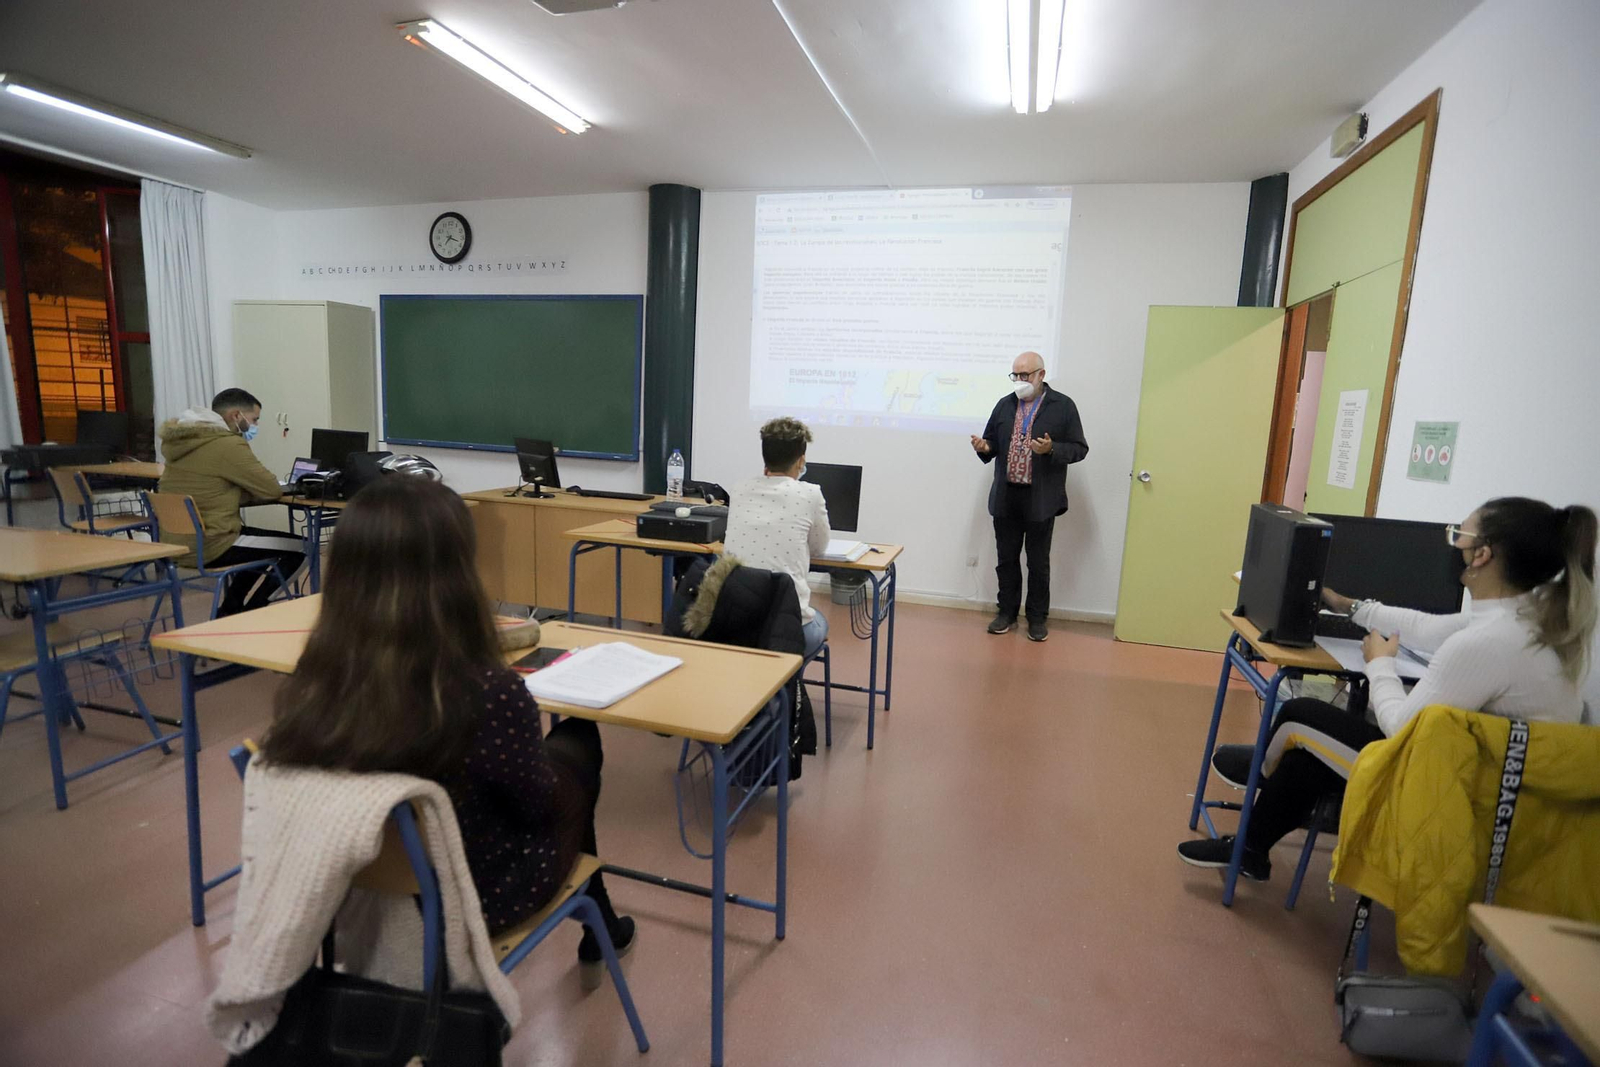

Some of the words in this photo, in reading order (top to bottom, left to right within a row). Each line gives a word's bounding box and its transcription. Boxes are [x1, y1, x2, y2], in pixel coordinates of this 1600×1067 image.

[309, 267, 315, 276] B
[318, 267, 324, 276] C
[337, 266, 344, 275] D
[345, 266, 350, 274] E
[361, 266, 368, 274] G
[410, 264, 415, 272] L
[418, 264, 426, 272] M
[429, 264, 435, 272] N
[457, 263, 463, 271] P
[468, 264, 475, 273] Q
[478, 263, 484, 272] R
[486, 263, 492, 272] S
[497, 263, 503, 271] T
[506, 262, 512, 271] U
[515, 262, 522, 271] V
[528, 262, 537, 270] W
[541, 261, 547, 269] X
[551, 261, 557, 269] Y
[560, 260, 566, 269] Z
[789, 368, 823, 377] EUROPA
[824, 369, 836, 378] EN
